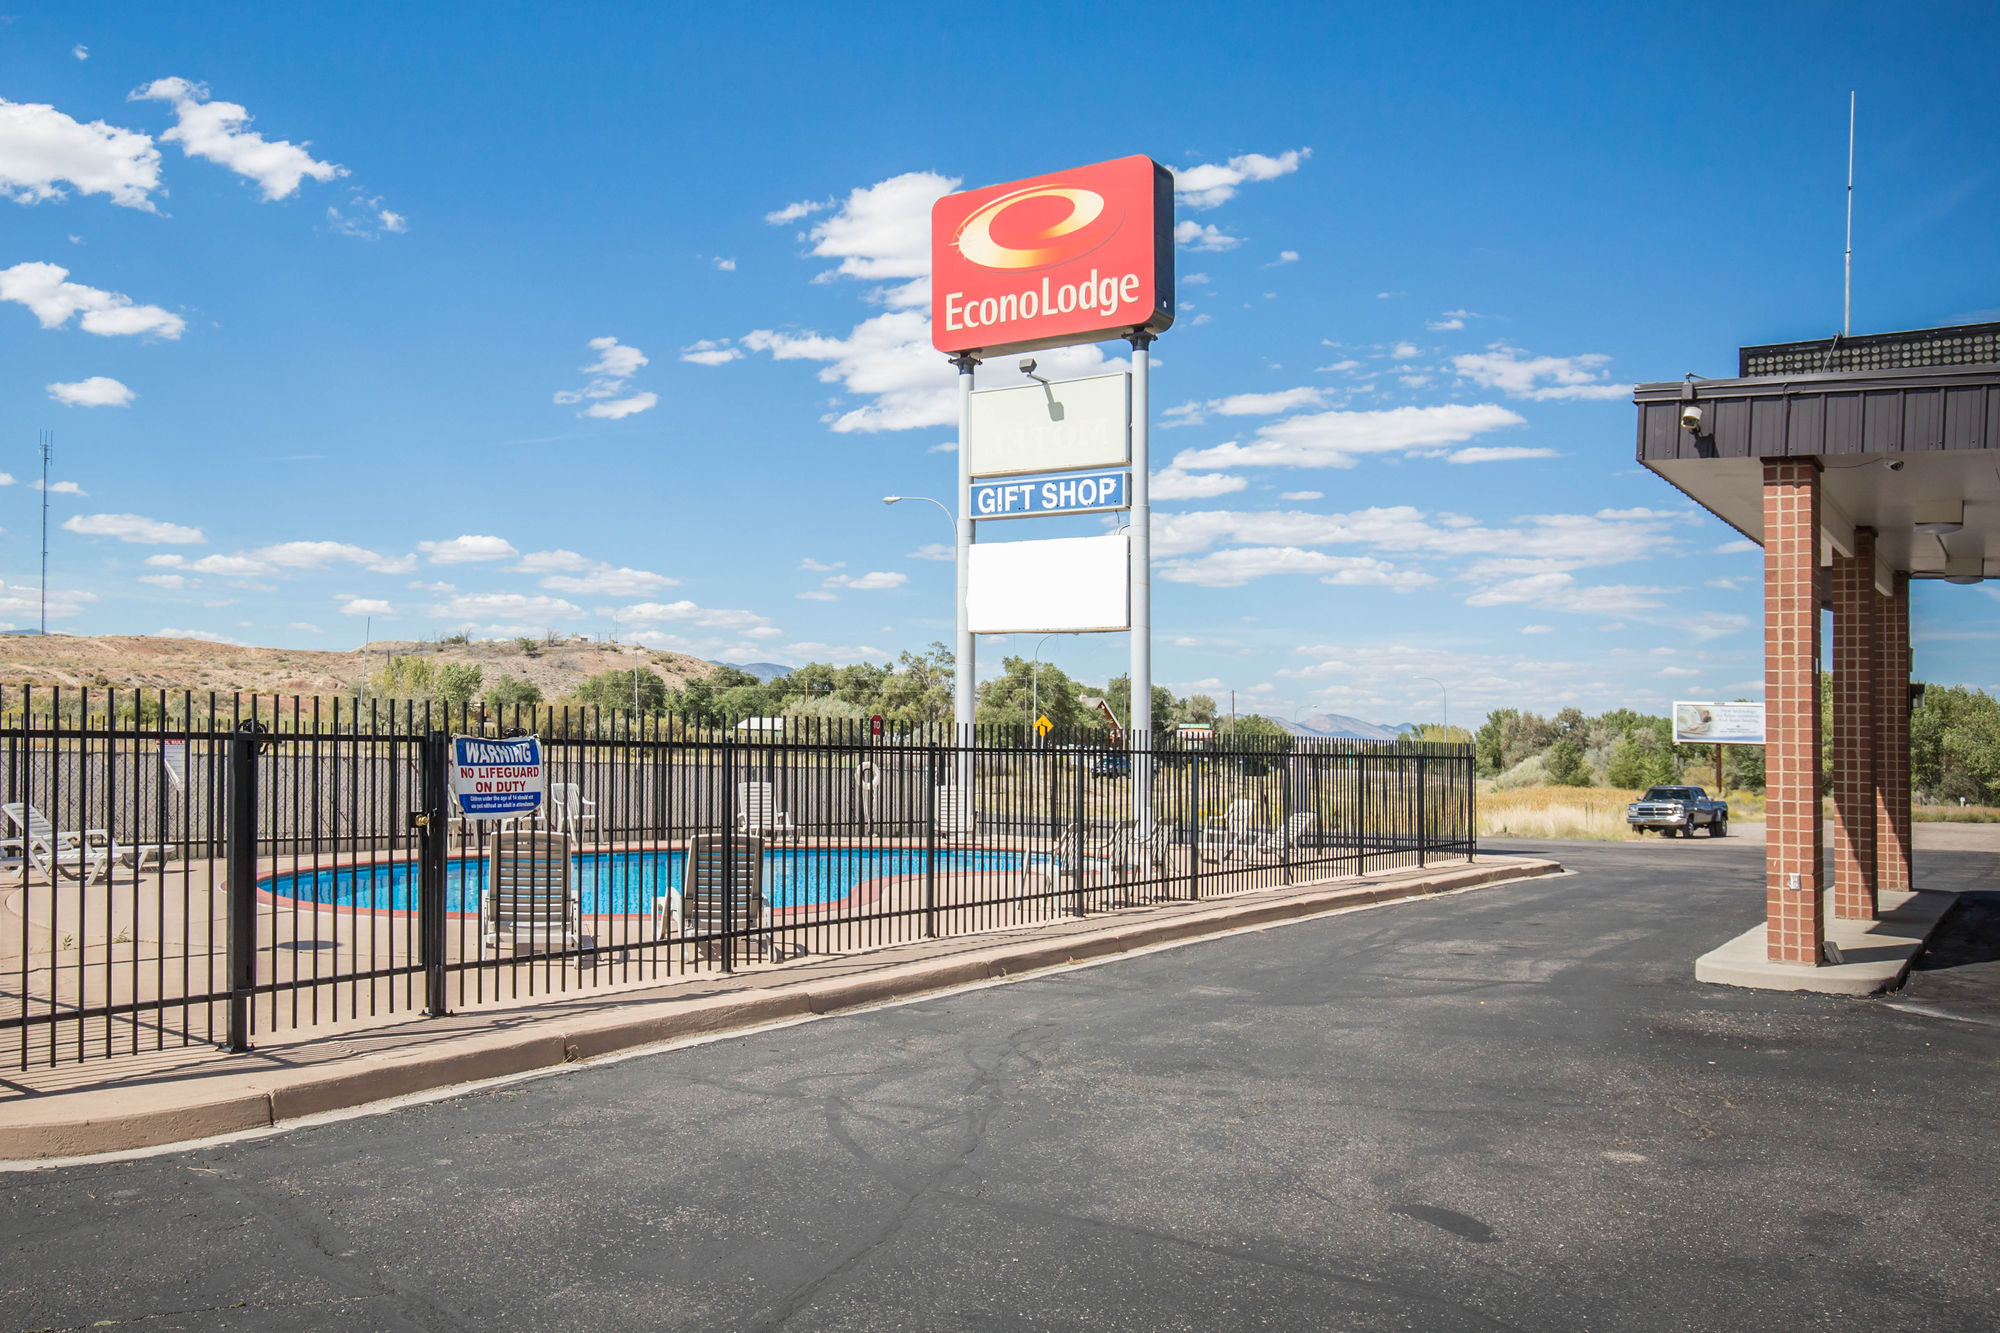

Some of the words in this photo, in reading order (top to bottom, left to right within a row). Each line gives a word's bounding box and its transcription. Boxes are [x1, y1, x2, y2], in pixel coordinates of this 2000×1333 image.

[945, 268, 1140, 332] EconoLodge
[978, 484, 1036, 514] GIFT
[1042, 477, 1118, 510] SHOP
[465, 742, 532, 763] WARNING
[460, 767, 474, 779] NO
[478, 766, 540, 779] LIFEGUARD
[475, 781, 492, 793] ON
[496, 781, 526, 792] DUTY
